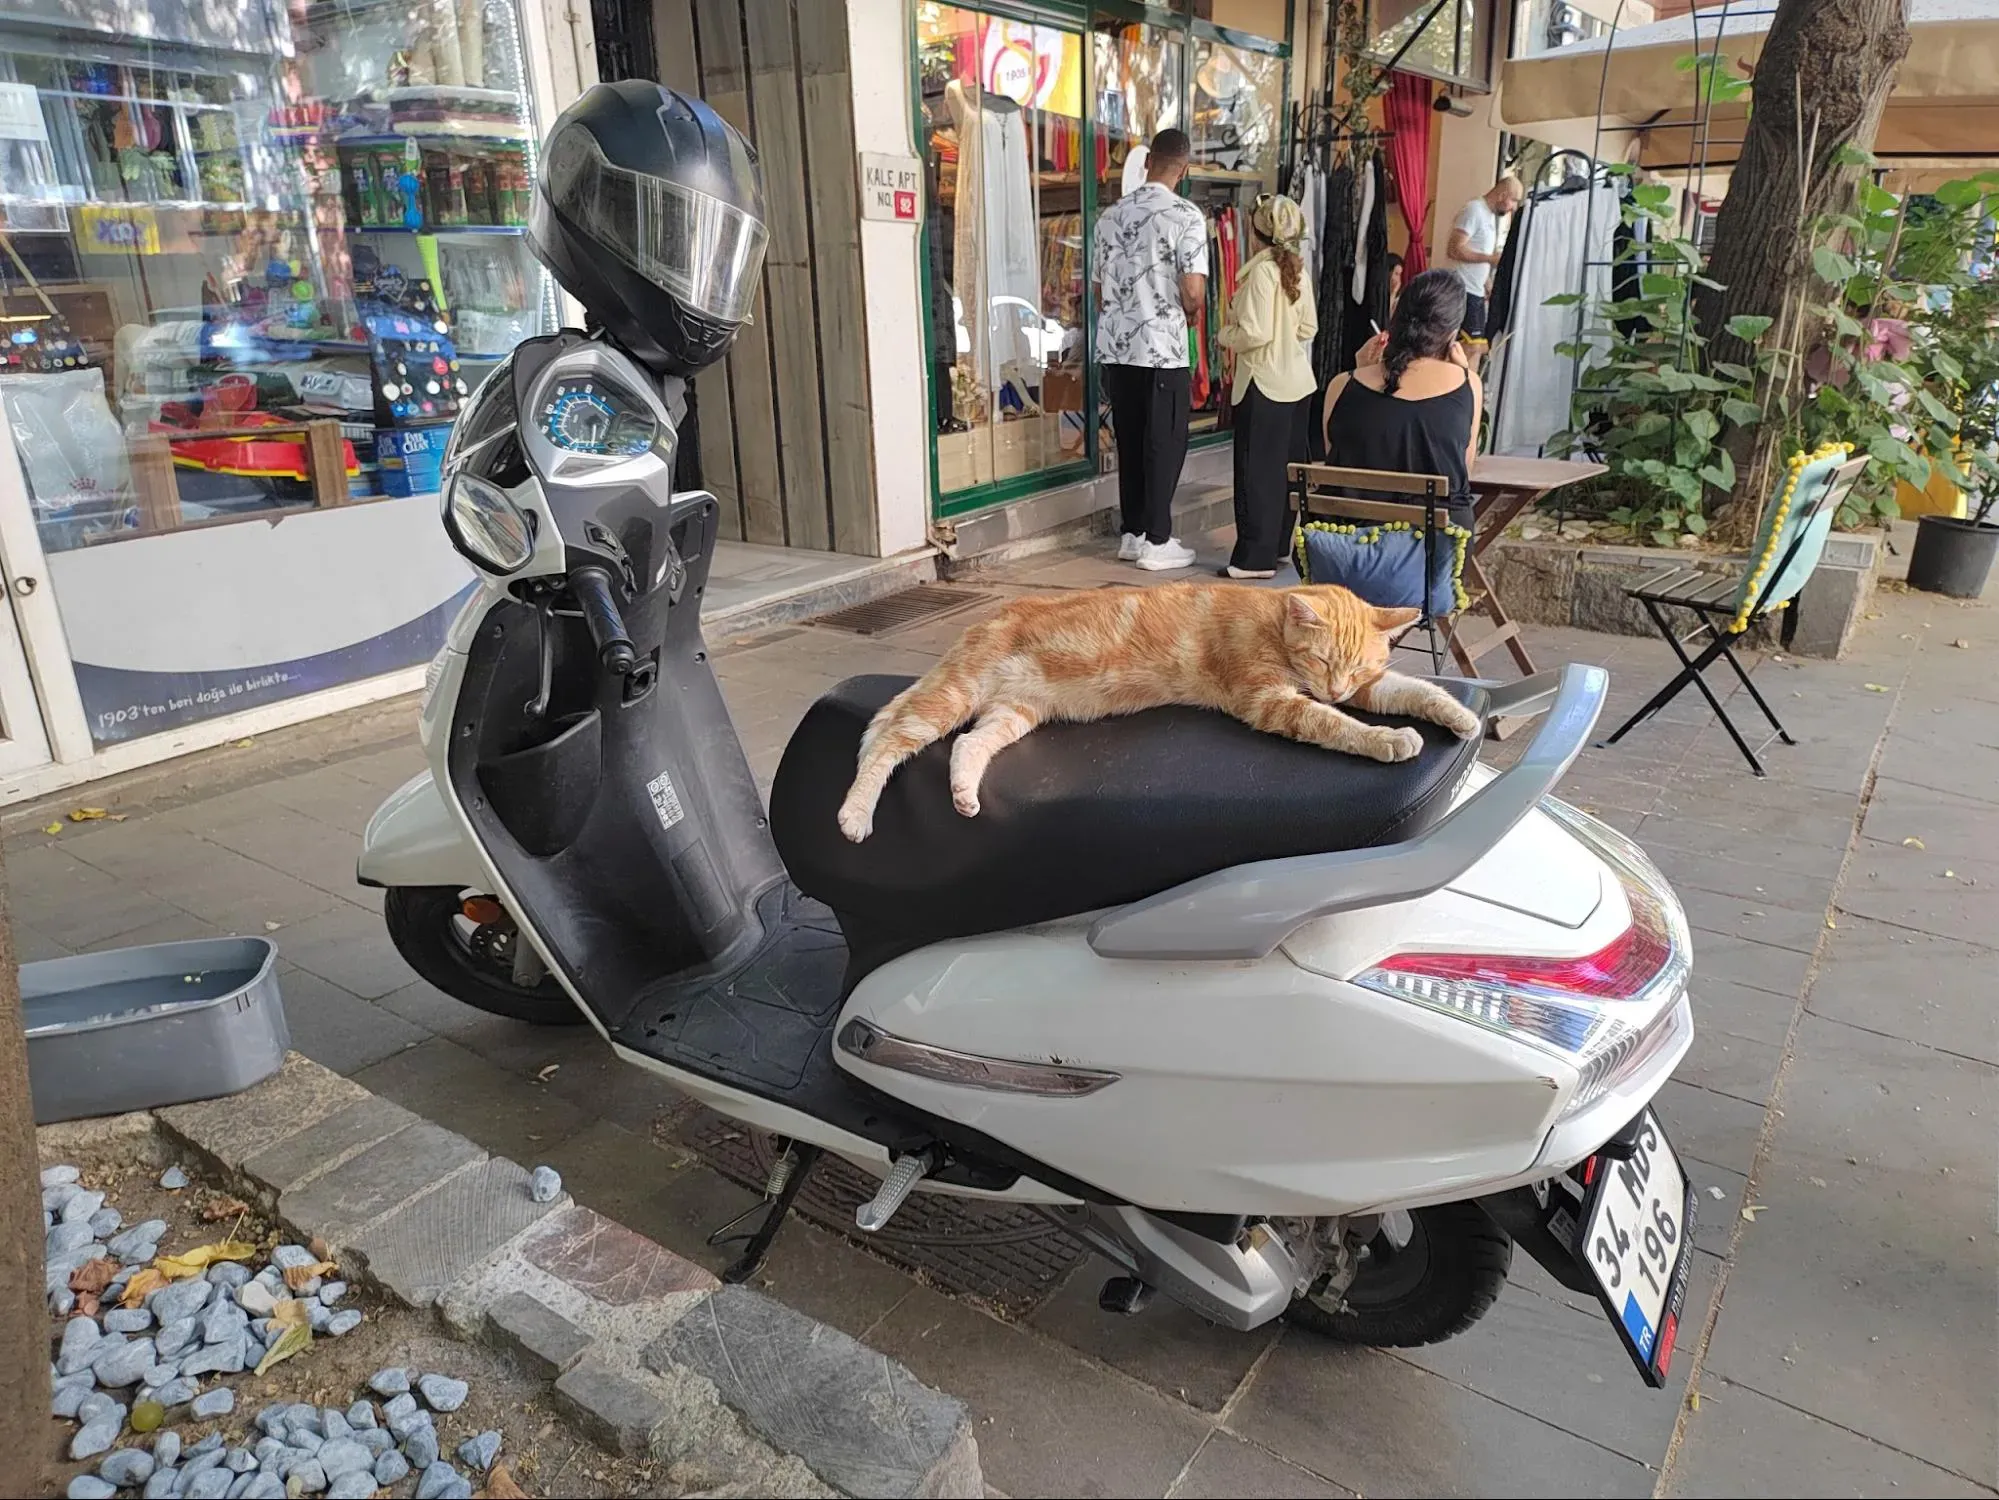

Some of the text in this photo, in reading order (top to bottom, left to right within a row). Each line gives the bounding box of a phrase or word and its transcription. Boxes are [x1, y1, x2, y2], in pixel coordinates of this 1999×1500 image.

[867, 167, 894, 188] KALE
[900, 196, 912, 214] 92
[98, 704, 167, 729] 1903'ten
[168, 697, 193, 711] beri
[196, 686, 226, 704] doğa
[228, 684, 243, 696] ile
[1596, 1204, 1631, 1288] 34
[1638, 1197, 1677, 1297] 196
[1639, 1325, 1652, 1353] TR
